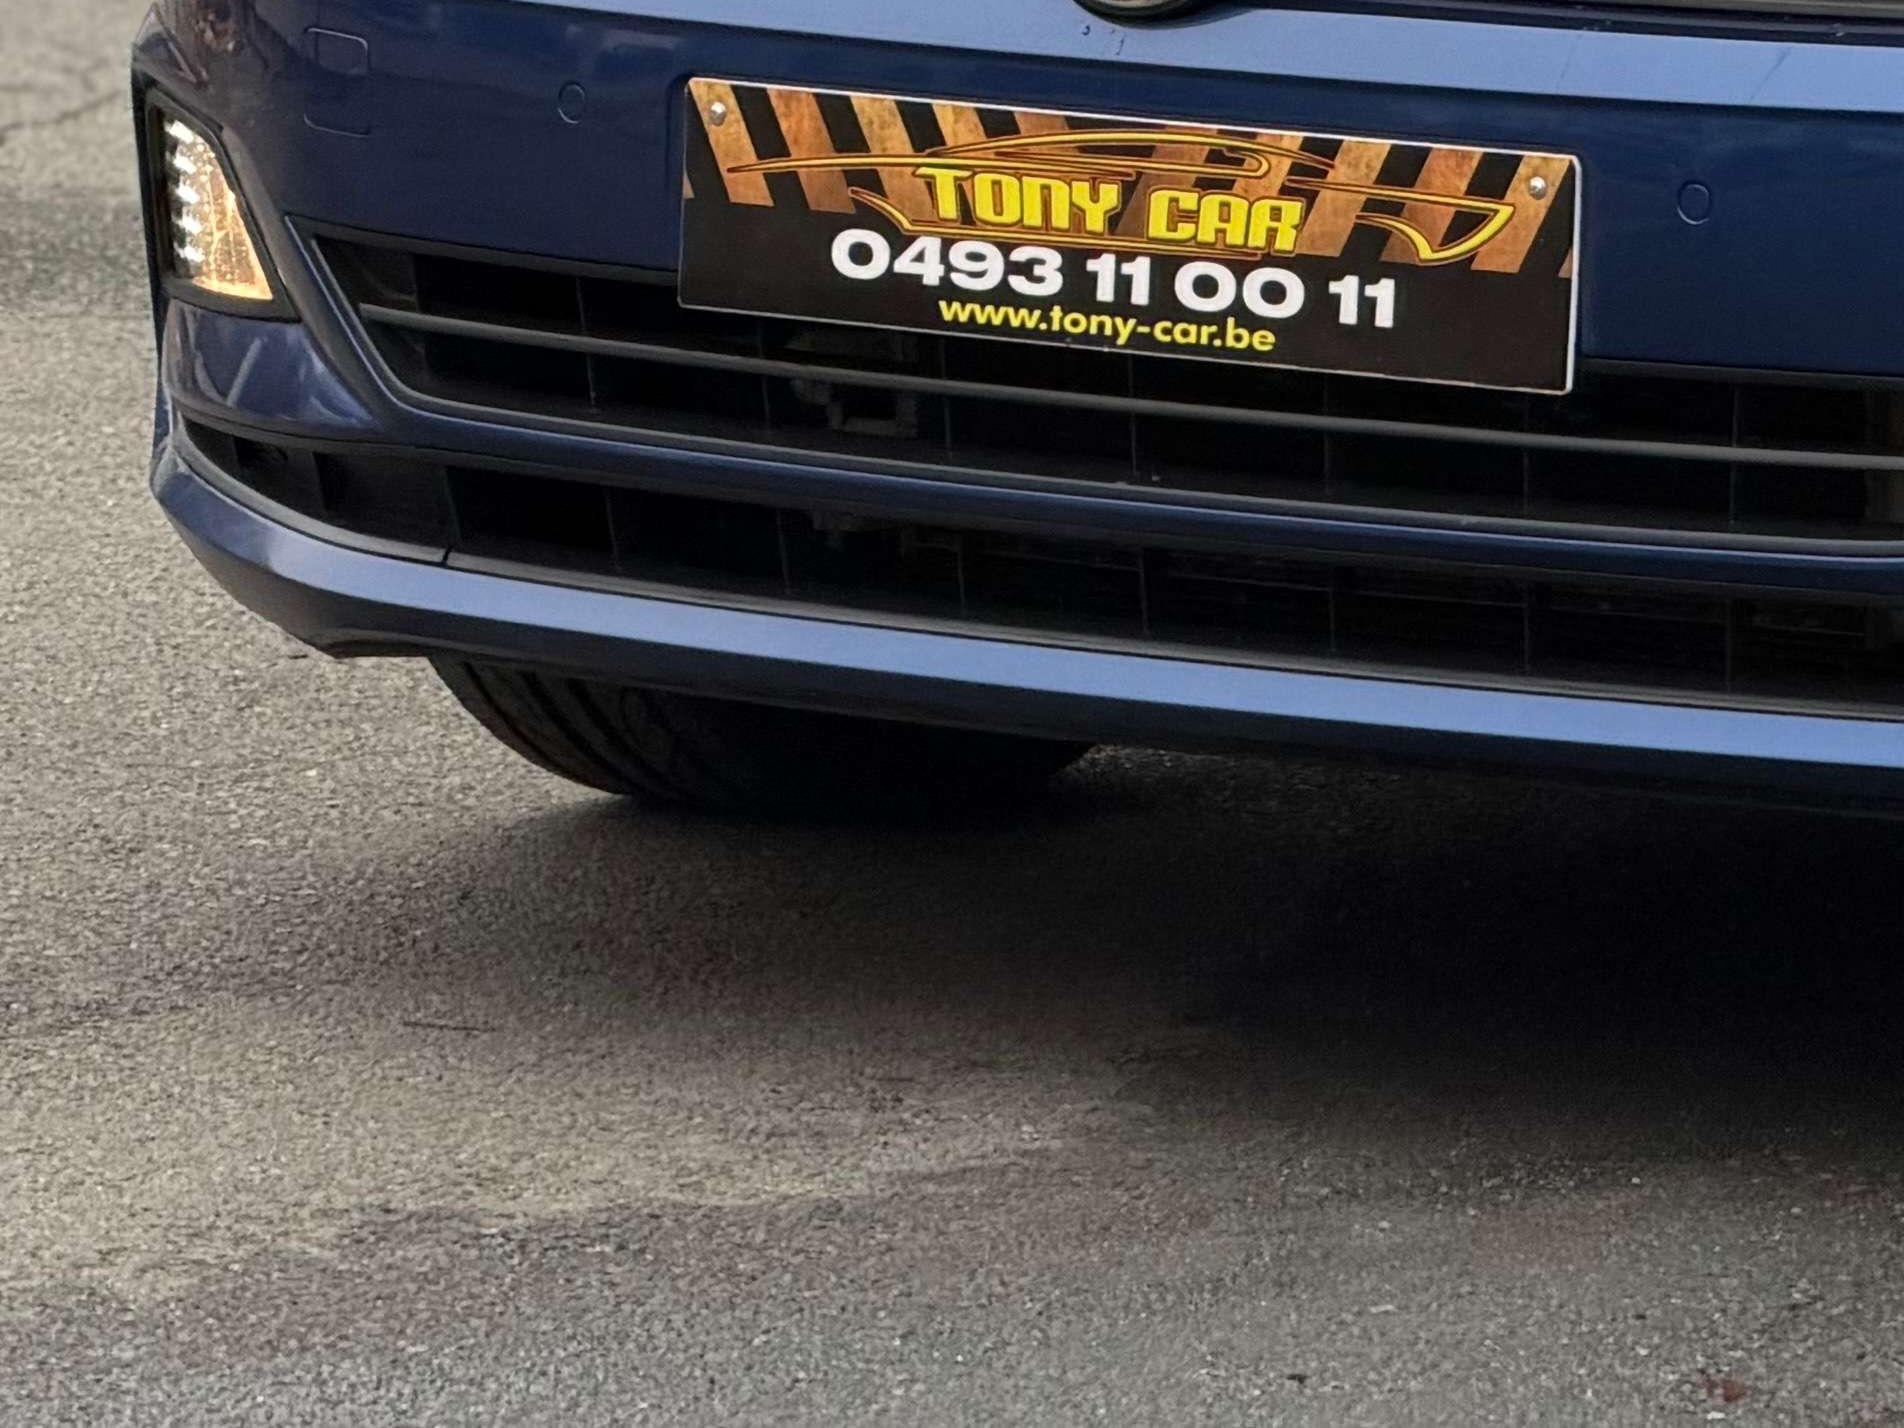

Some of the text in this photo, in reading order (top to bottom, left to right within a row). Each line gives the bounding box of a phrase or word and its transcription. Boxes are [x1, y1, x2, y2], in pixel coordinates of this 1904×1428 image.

[915, 166, 1305, 254] TONY CAR
[831, 227, 1396, 329] 0493 11 00 11
[938, 295, 1277, 353] www.tony-car.be
